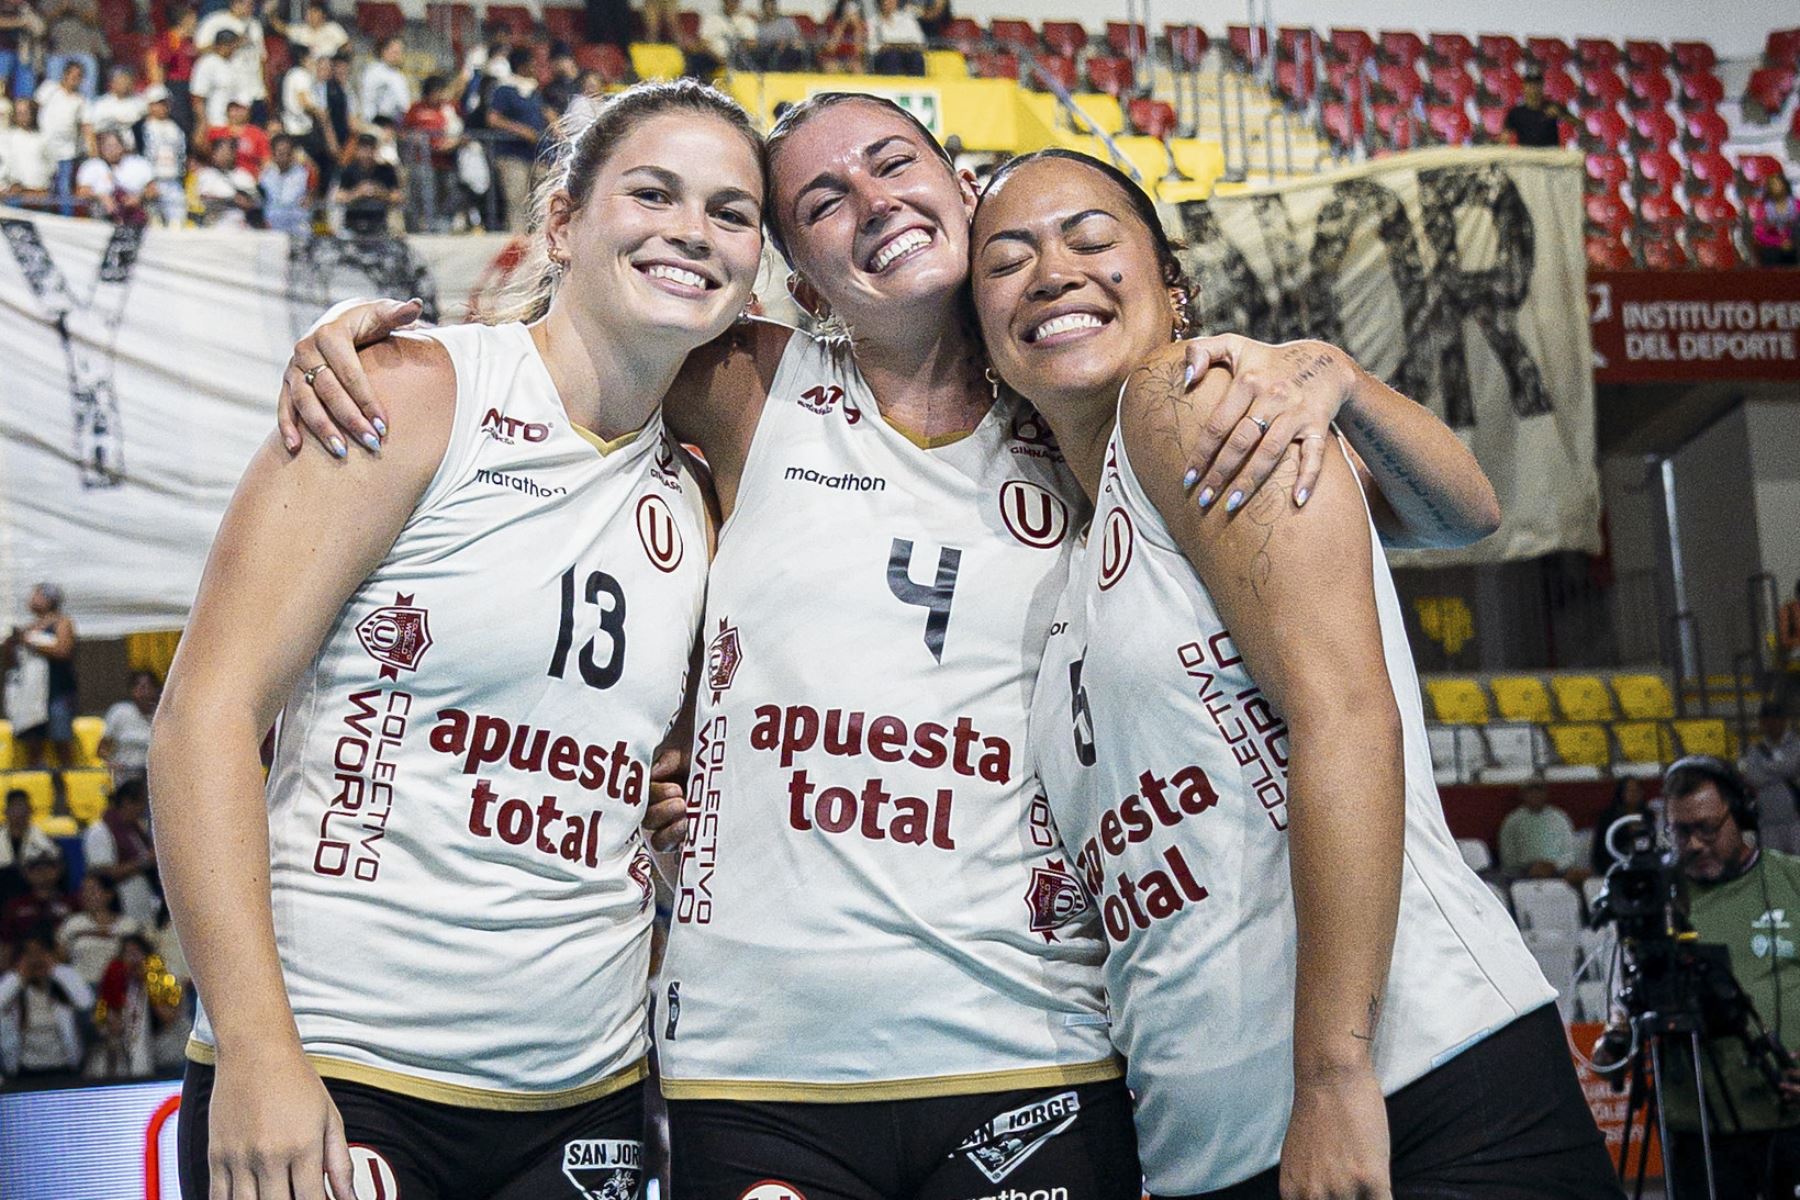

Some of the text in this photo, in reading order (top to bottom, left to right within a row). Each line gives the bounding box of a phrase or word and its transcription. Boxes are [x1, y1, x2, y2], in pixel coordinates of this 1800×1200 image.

[1622, 301, 1758, 330] INSTITUTO
[1625, 331, 1796, 361] DEL DEPORTE
[476, 469, 567, 498] marathon
[785, 467, 886, 491] marathon
[547, 563, 626, 690] 13
[886, 537, 962, 665] 4
[313, 689, 382, 876] WORLD
[429, 708, 643, 807] apuesta
[750, 703, 1011, 785] apuesta
[1177, 642, 1288, 832] COLECTIVO
[354, 691, 412, 882] COLECTIVO
[468, 779, 603, 868] total
[697, 716, 727, 924] COLECTIVO
[788, 769, 955, 850] total
[1104, 844, 1209, 942] otal
[567, 1143, 607, 1165] SAN
